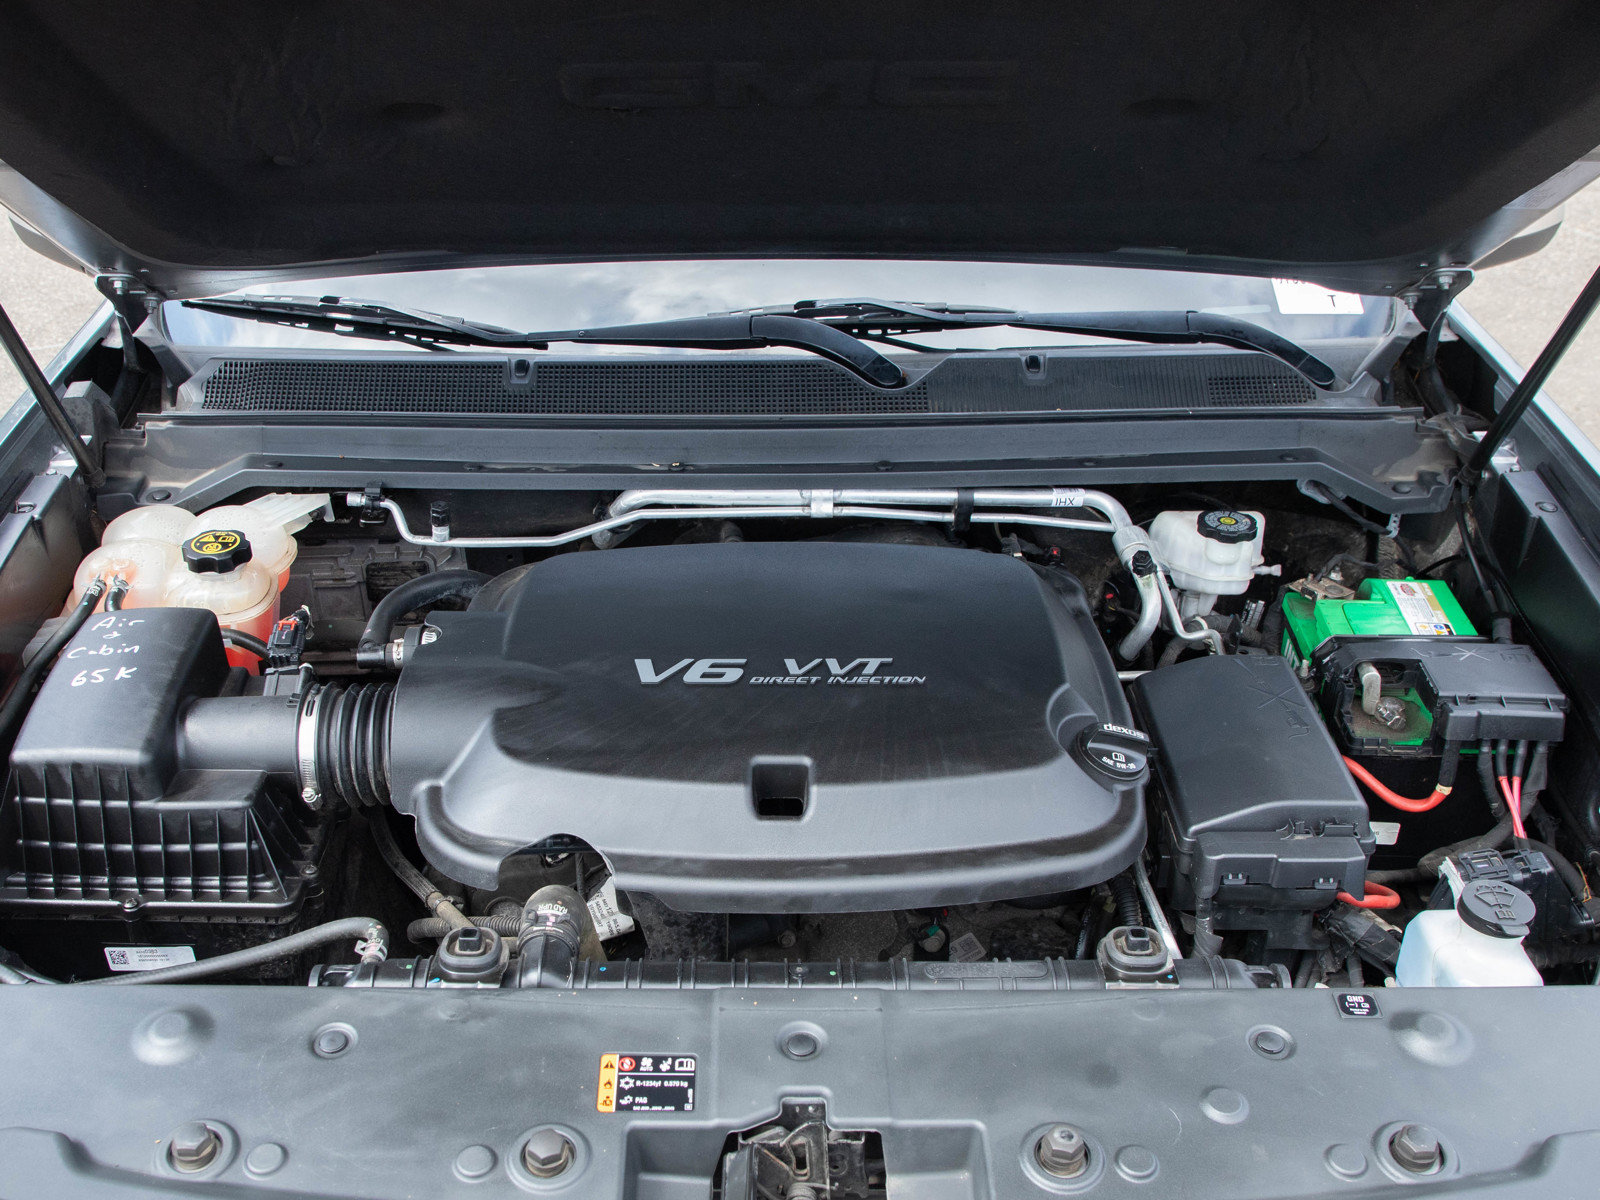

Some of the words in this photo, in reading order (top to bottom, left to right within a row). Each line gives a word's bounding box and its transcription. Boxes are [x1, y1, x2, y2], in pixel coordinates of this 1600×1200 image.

[91, 616, 145, 631] Air
[634, 658, 748, 686] V6
[783, 657, 894, 677] VVT
[749, 675, 822, 686] DIRECT
[827, 675, 927, 686] INJECTION
[1103, 723, 1145, 739] dexos
